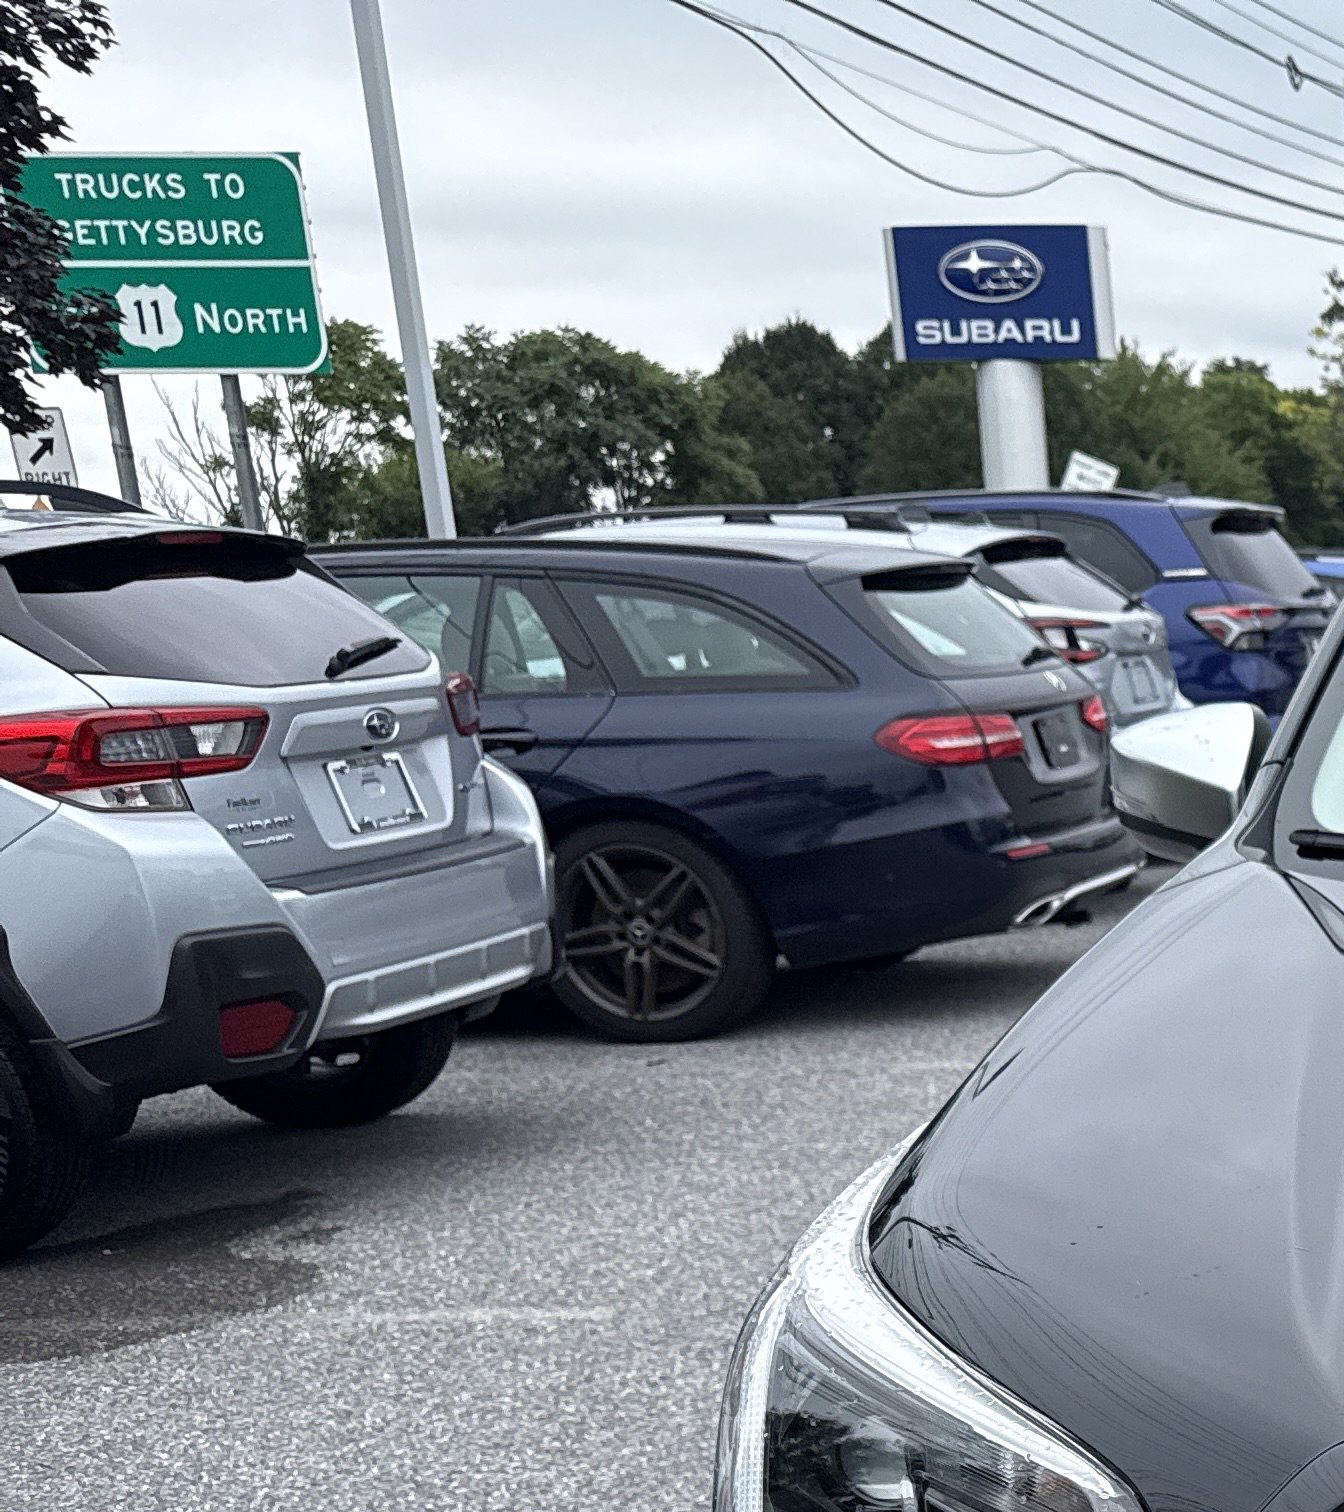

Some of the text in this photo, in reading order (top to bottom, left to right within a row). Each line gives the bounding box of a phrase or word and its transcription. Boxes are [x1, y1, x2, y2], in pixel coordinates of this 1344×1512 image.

[54, 172, 245, 199] TRUCKS TO
[133, 299, 308, 335] 11 NORTH
[914, 317, 1082, 345] SUBARU
